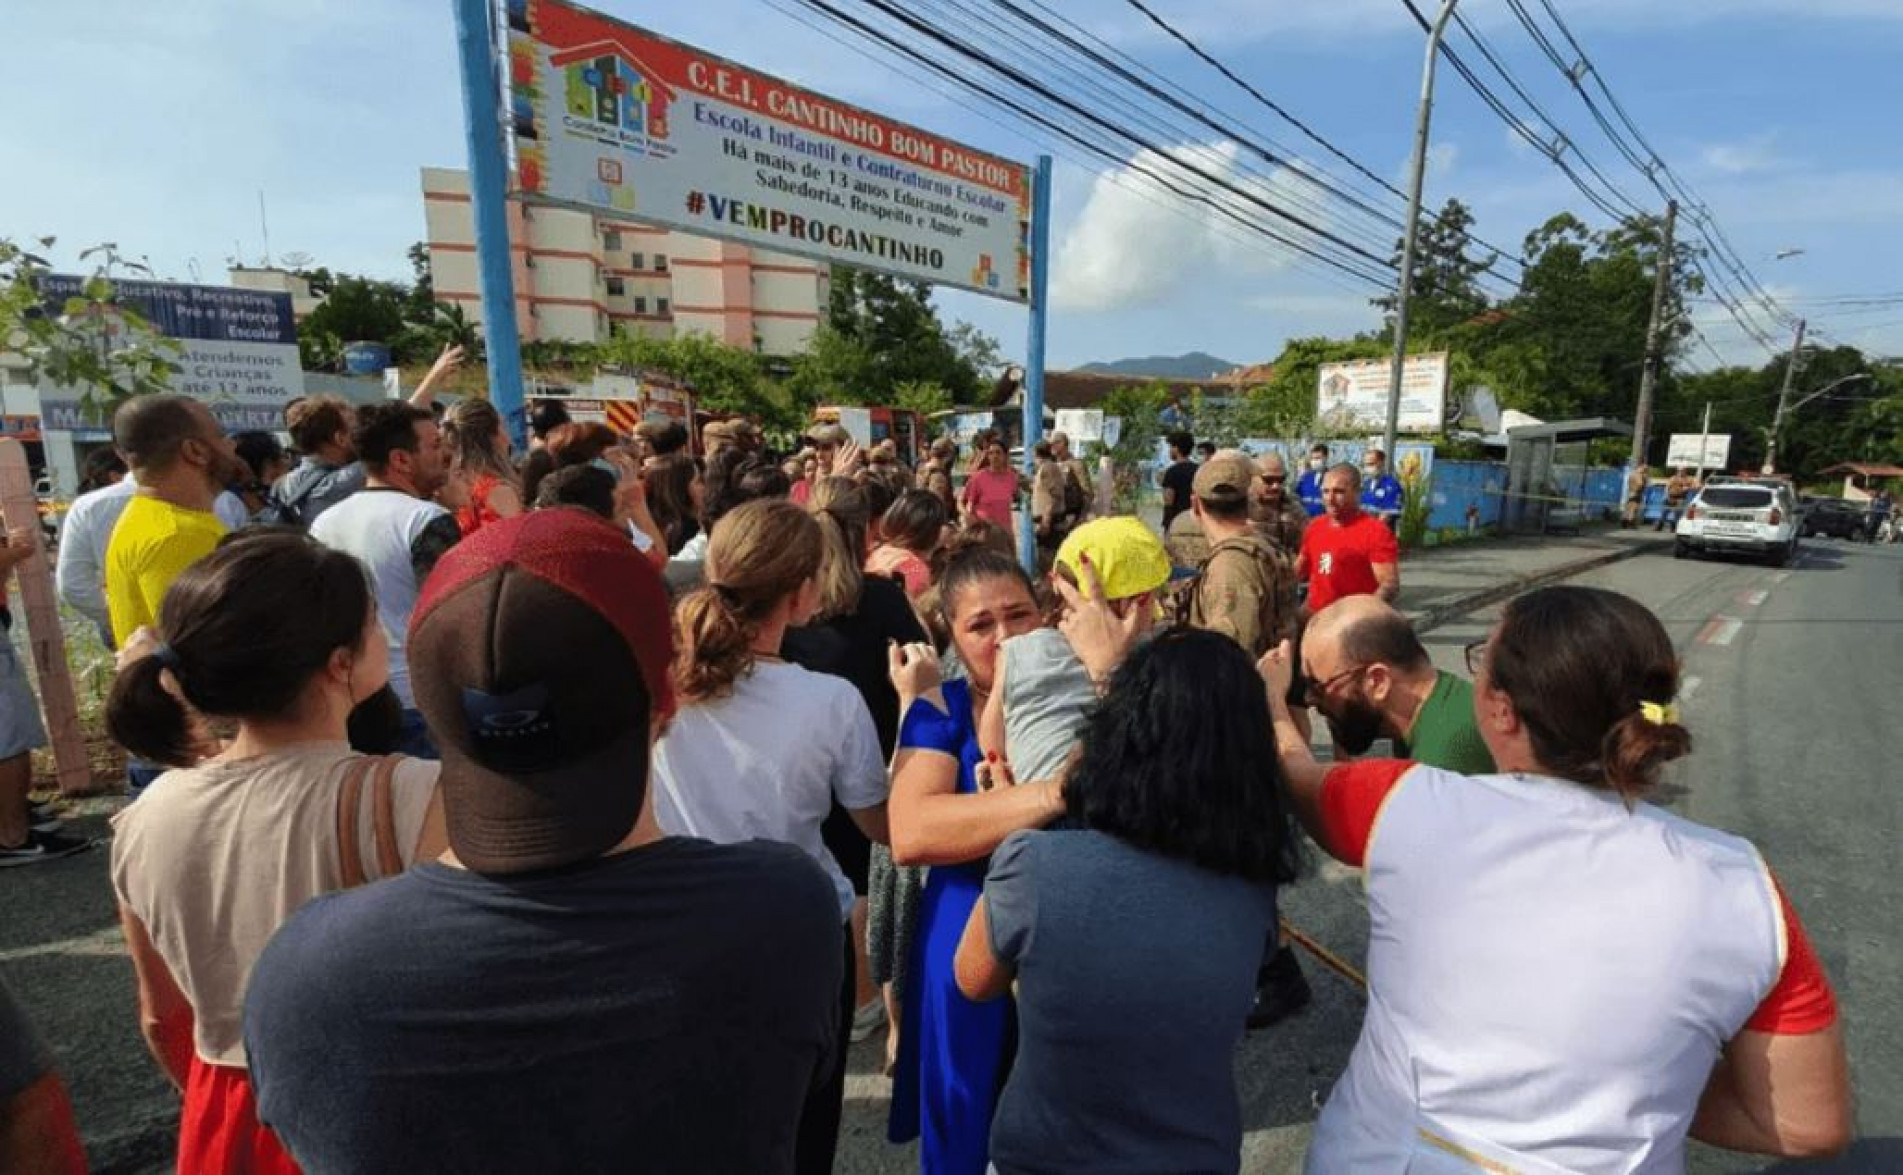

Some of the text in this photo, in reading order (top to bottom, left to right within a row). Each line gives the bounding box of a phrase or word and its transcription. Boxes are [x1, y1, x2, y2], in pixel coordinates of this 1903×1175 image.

[688, 61, 758, 107] C.E.I.
[768, 90, 884, 148] CANTINHO
[891, 130, 936, 165] BOM
[941, 147, 1010, 189] PASTOR
[694, 102, 1006, 213] Escola Infantil e Contraturno Escolar
[723, 137, 989, 227] Há mais de 13 anos Educando com
[756, 168, 845, 208] Sabedoria,
[851, 195, 913, 226] Respeito
[929, 216, 963, 237] Amor
[687, 190, 944, 269] #VEMPROCANTINHO
[206, 308, 215, 319] e
[228, 325, 281, 340] Escolar
[195, 364, 272, 382] Crianças
[246, 385, 288, 397] anos
